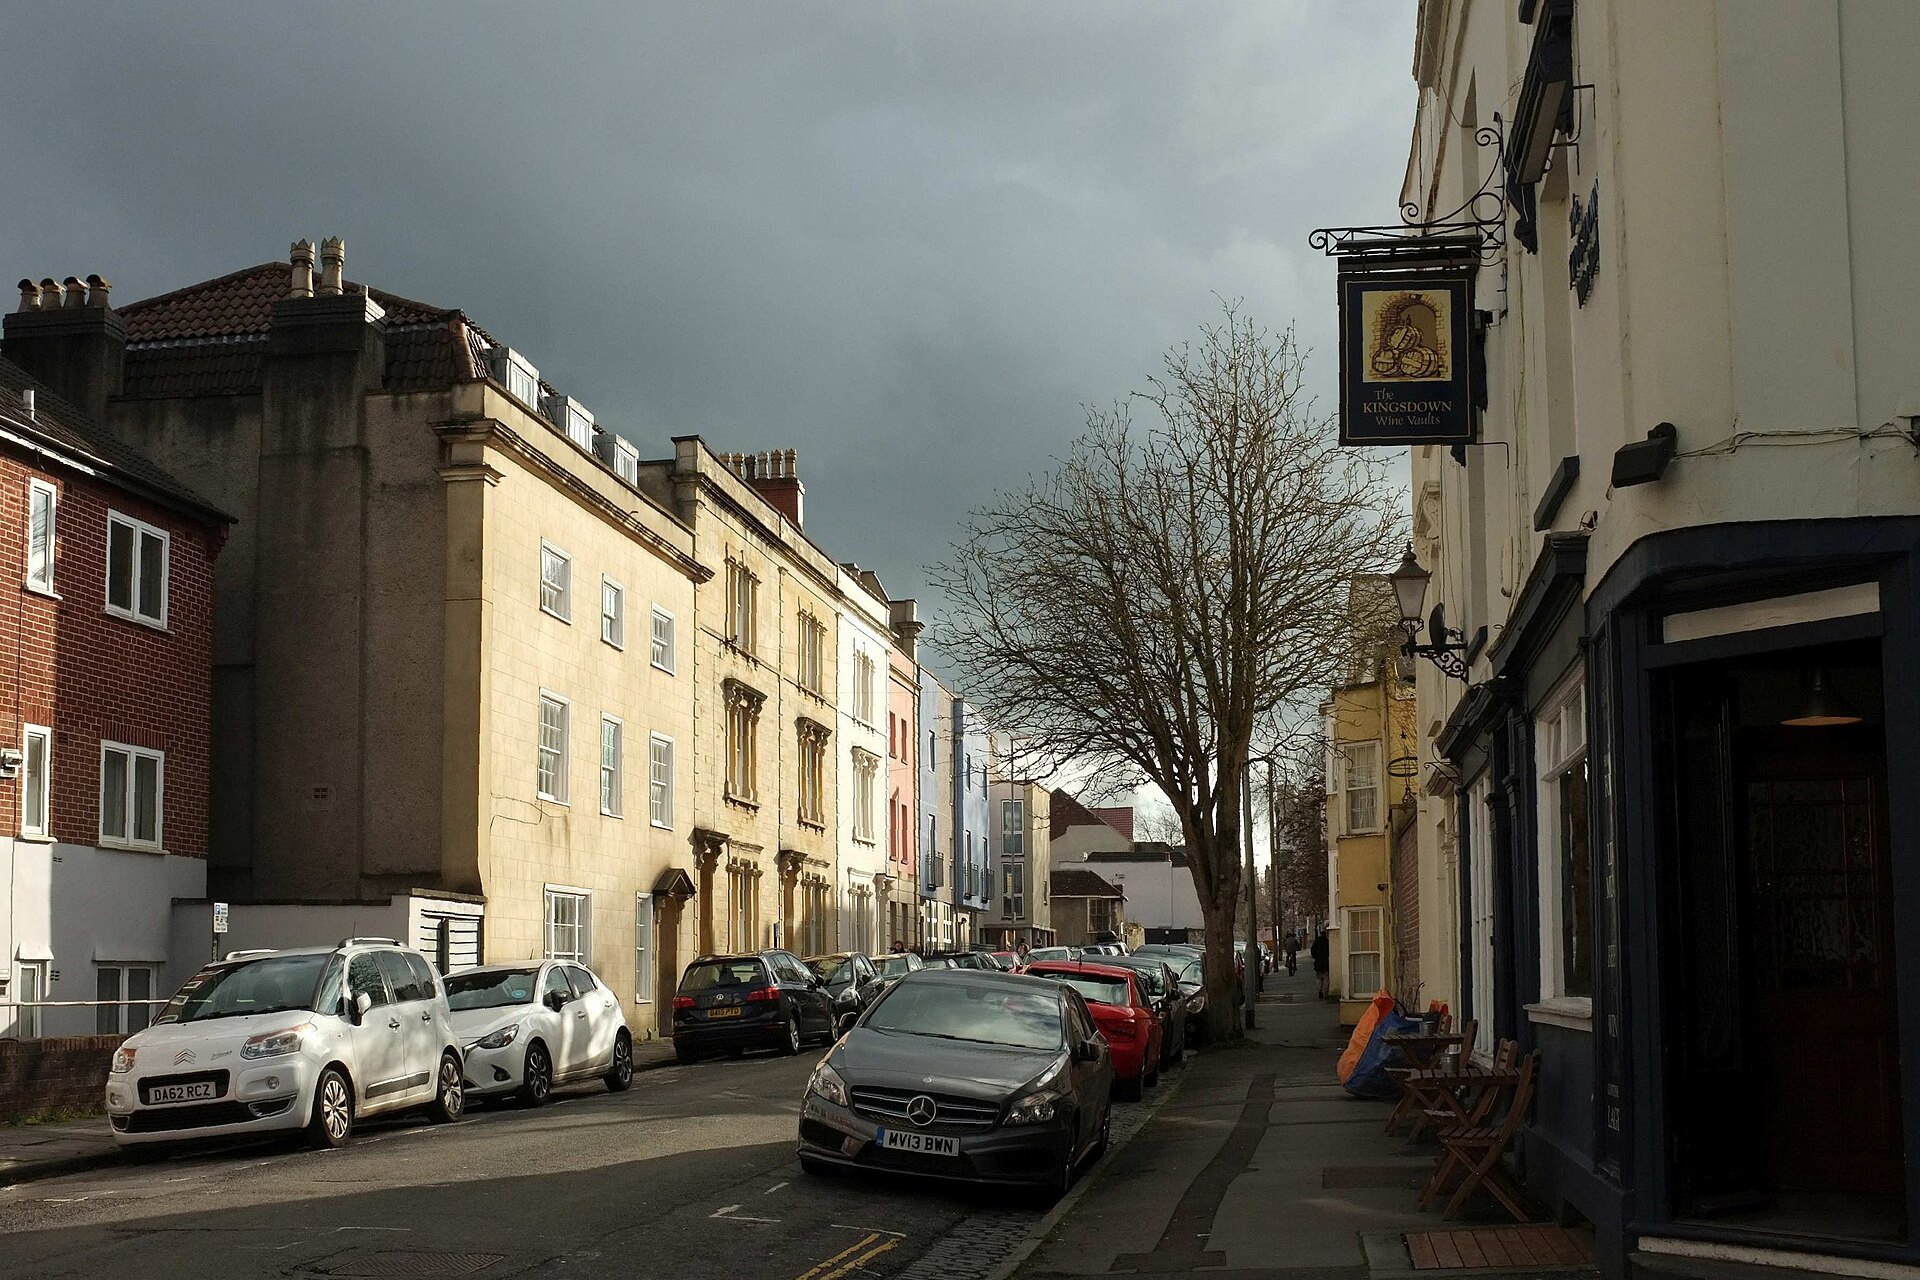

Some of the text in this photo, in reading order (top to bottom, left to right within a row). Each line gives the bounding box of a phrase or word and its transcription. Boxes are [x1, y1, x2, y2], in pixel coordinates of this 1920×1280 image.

[1374, 387, 1394, 402] The
[1362, 401, 1453, 414] KINGSDOWN
[1375, 411, 1442, 426] Wine Vaults
[153, 1083, 211, 1102] DA62 RCZ
[888, 1131, 954, 1154] MV13 BWN
